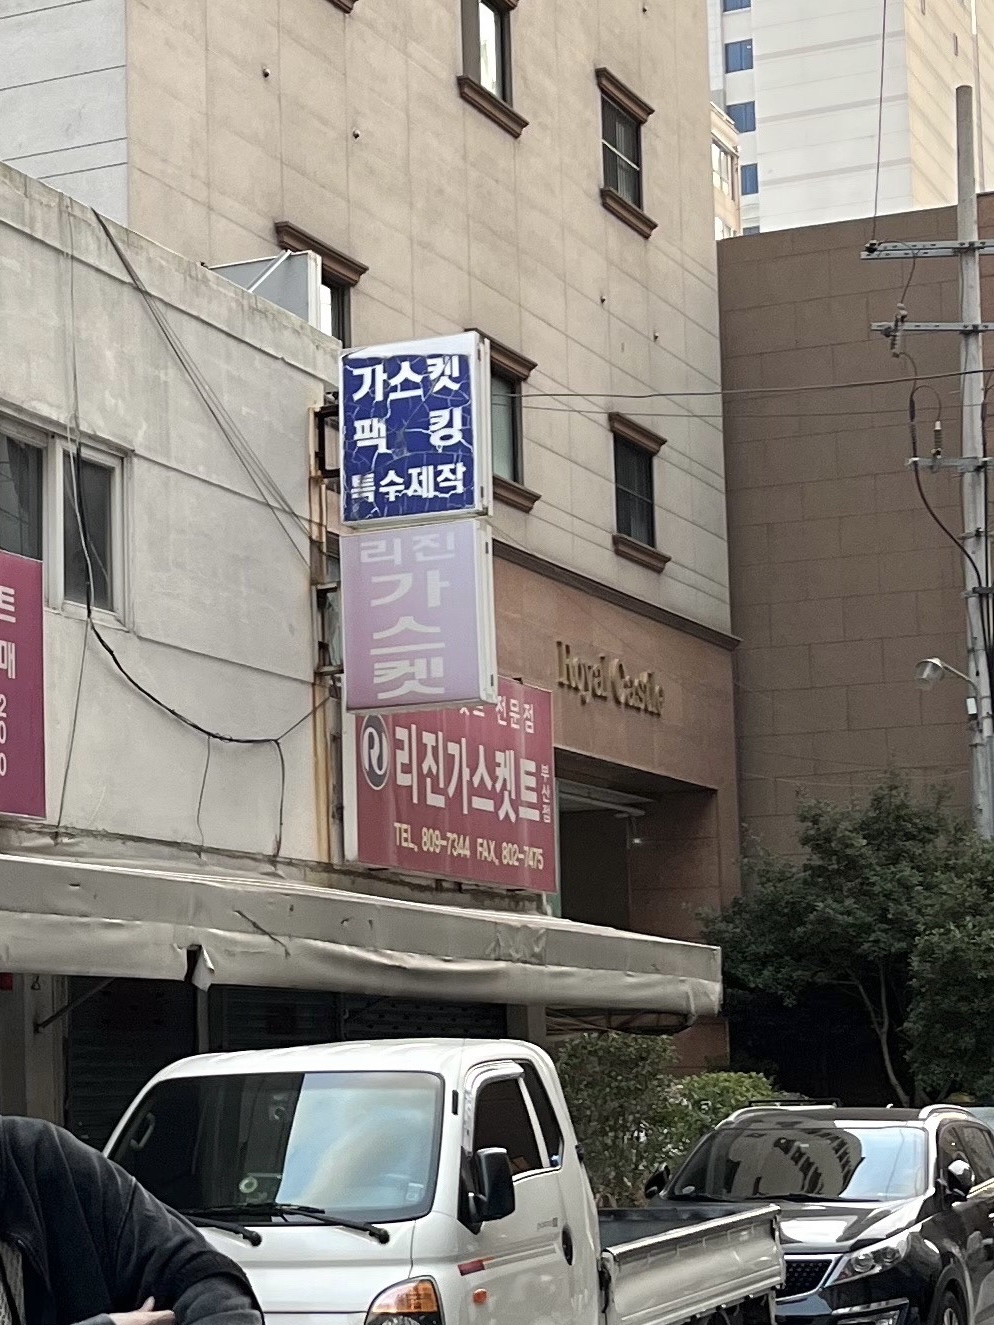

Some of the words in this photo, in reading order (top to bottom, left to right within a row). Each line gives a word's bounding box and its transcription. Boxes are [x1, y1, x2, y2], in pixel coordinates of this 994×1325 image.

[352, 356, 461, 402] 가스켓
[351, 462, 467, 502] 특수제작
[360, 531, 456, 566] 리진
[556, 640, 608, 706] Royal
[608, 657, 665, 717] Castle
[495, 695, 535, 734] 전문점
[395, 723, 541, 824] 리진가스켓트
[421, 826, 471, 859] 809-7344
[501, 841, 545, 870] 802-7475
